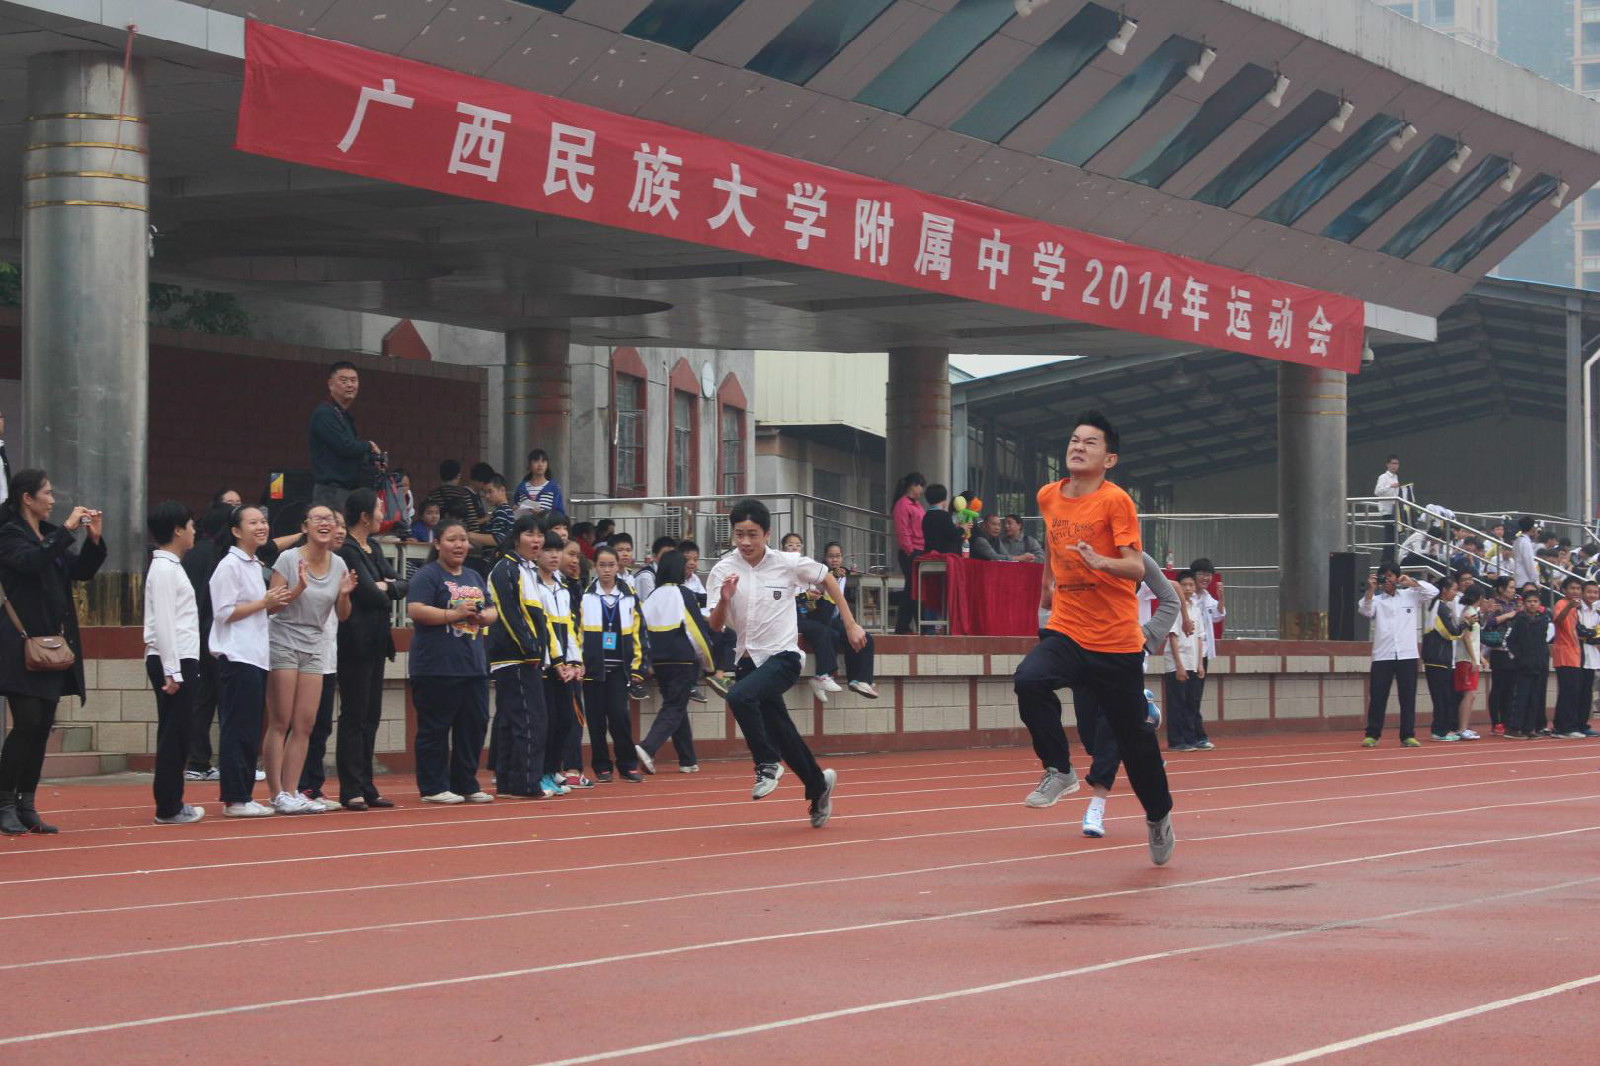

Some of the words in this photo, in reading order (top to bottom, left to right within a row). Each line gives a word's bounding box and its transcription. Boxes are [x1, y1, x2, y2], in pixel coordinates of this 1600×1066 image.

[336, 78, 1334, 357] 广西民族大学附属中学2014年运动会
